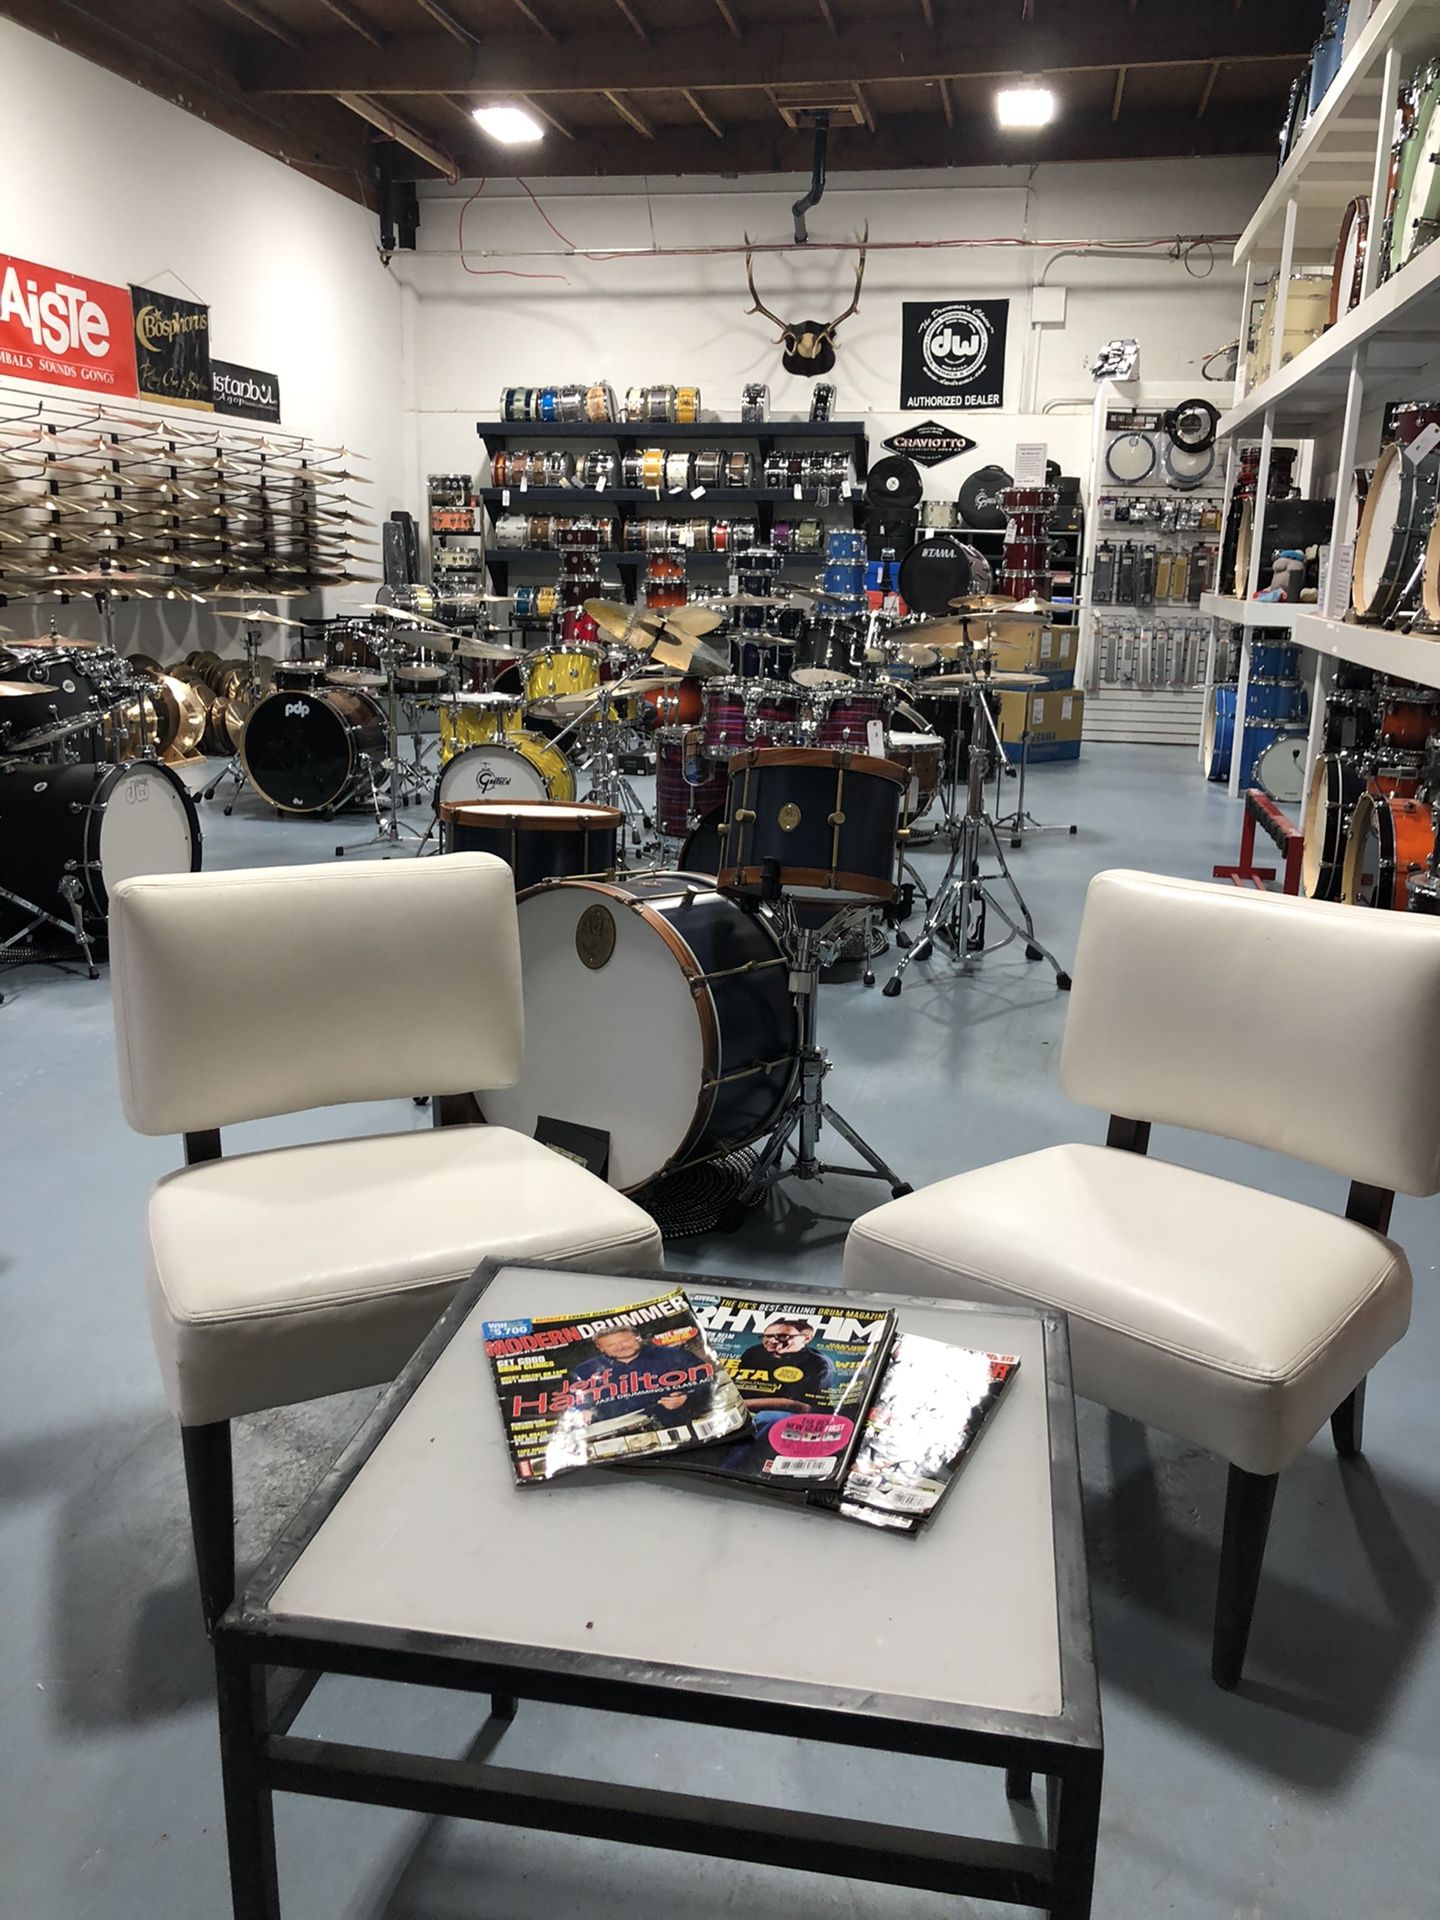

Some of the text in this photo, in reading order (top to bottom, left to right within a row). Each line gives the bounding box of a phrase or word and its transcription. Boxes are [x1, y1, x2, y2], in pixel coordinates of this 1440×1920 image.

[931, 328, 980, 357] dw
[39, 359, 77, 378] SOUNDS
[80, 367, 115, 384] GONGS
[907, 394, 1000, 407] AUTHORIZED DEALER
[893, 437, 966, 448] CRAVIOTTO
[285, 701, 310, 717] pdp
[721, 1299, 738, 1308] THE
[738, 1301, 758, 1310] UK'S
[759, 1304, 817, 1315] BEST-SELLING
[818, 1307, 844, 1317] DRUM
[484, 1326, 582, 1357] MODERN
[577, 1295, 690, 1339] DRUMMER
[512, 1363, 714, 1417] Hamilton
[552, 1368, 613, 1395] Jeff
[596, 1395, 616, 1405] JAZZ
[616, 1386, 671, 1399] DRUMMING'S
[672, 1381, 697, 1390] CLASS
[824, 1424, 846, 1432] FIRST
